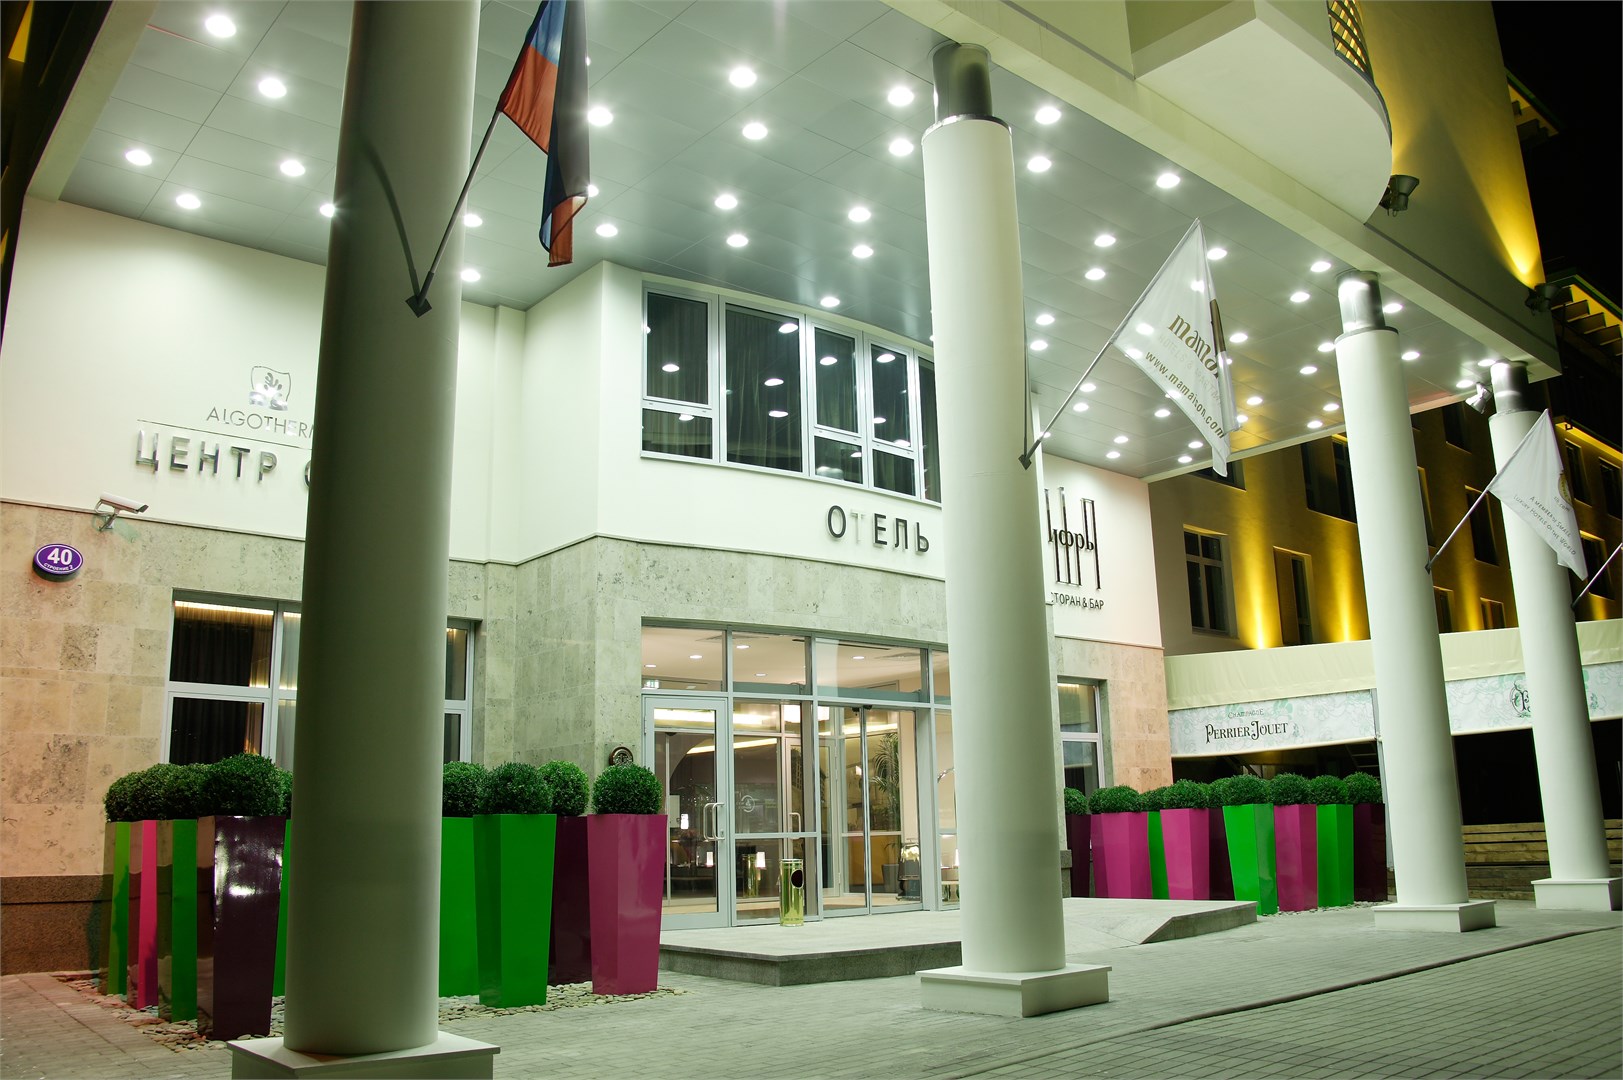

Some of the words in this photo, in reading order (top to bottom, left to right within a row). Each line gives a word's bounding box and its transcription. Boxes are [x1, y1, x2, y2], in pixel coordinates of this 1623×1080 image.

[1168, 315, 1218, 379] mama
[1145, 352, 1225, 439] www.mamaison.com
[206, 407, 314, 439] ALGOTHER
[135, 429, 278, 483] ЦЕНТР
[826, 505, 930, 553] ОТЕЛЬ
[47, 547, 72, 566] 40
[1051, 592, 1081, 607] ТОРАН
[1082, 597, 1088, 608] &
[1089, 598, 1105, 610] БАР
